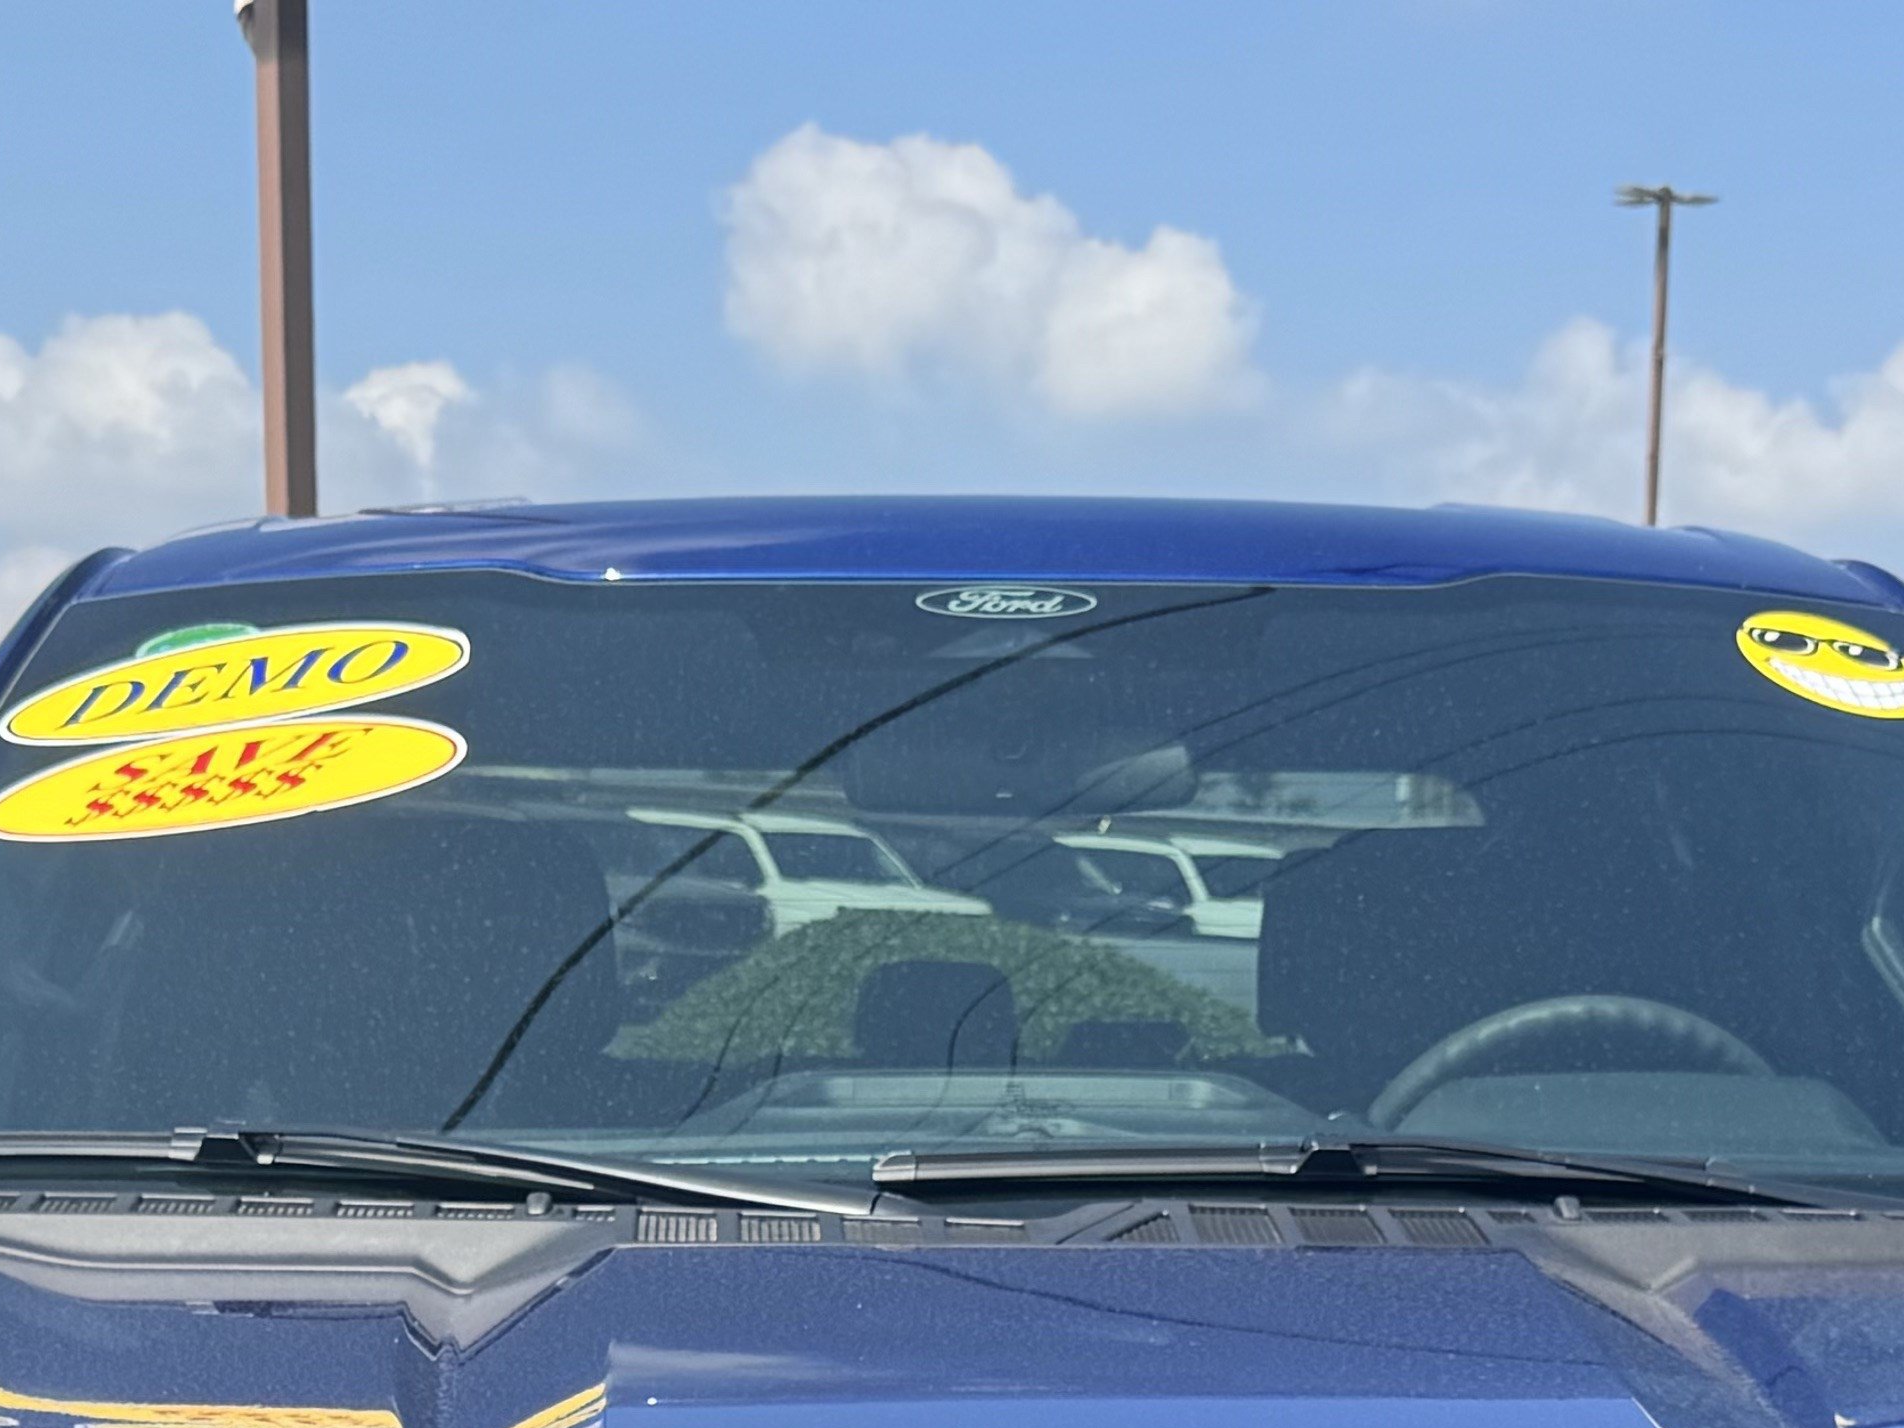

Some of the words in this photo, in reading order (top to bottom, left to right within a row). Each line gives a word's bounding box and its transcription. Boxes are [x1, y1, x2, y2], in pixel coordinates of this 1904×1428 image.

[947, 590, 1064, 613] Ford
[56, 640, 409, 729] DEMO
[88, 727, 374, 793] SAVE
